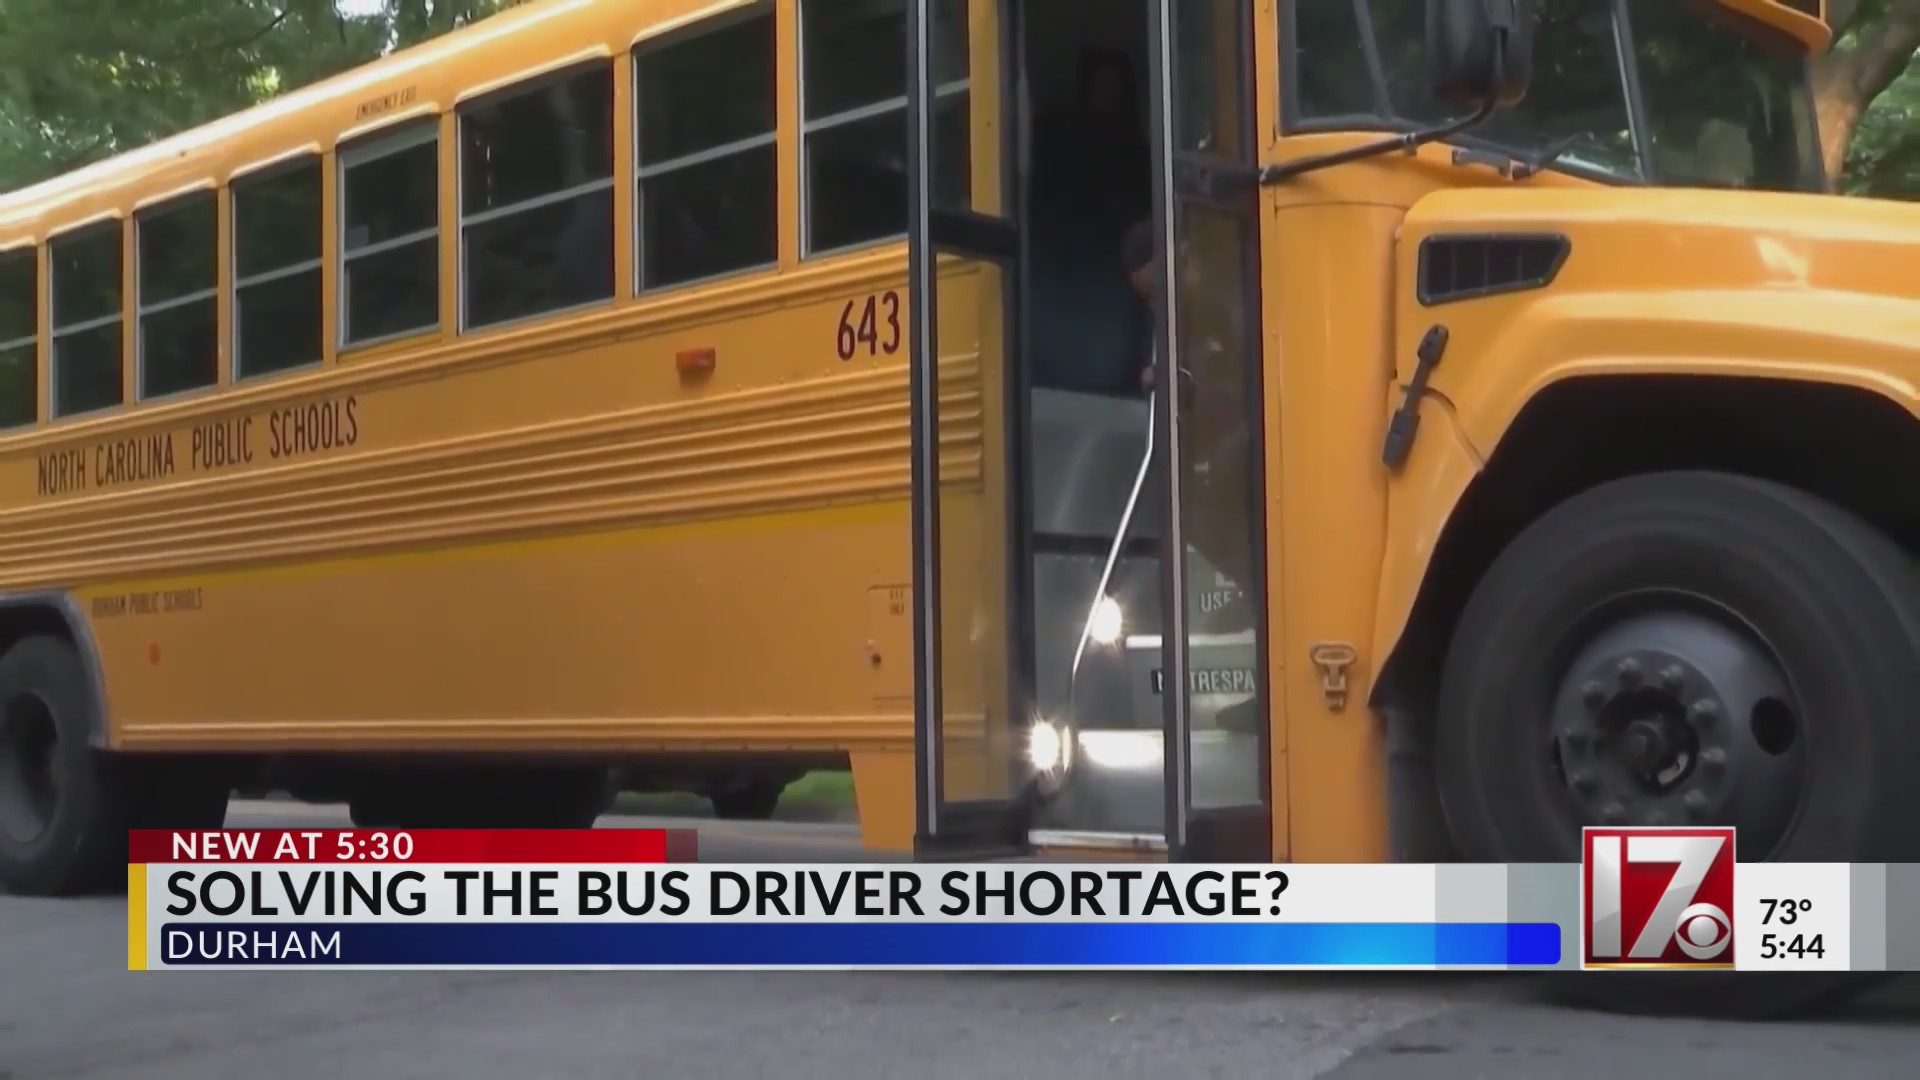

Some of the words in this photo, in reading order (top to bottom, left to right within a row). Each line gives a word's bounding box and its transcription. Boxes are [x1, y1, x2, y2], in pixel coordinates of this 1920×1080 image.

[837, 291, 901, 361] 643
[38, 448, 86, 496] NORTH
[95, 433, 174, 487] CAROLINA
[192, 417, 253, 471] PUBLIC
[269, 395, 357, 459] SCHOOLS
[129, 591, 159, 615] PUBLIC
[1189, 669, 1256, 692] TRESPA
